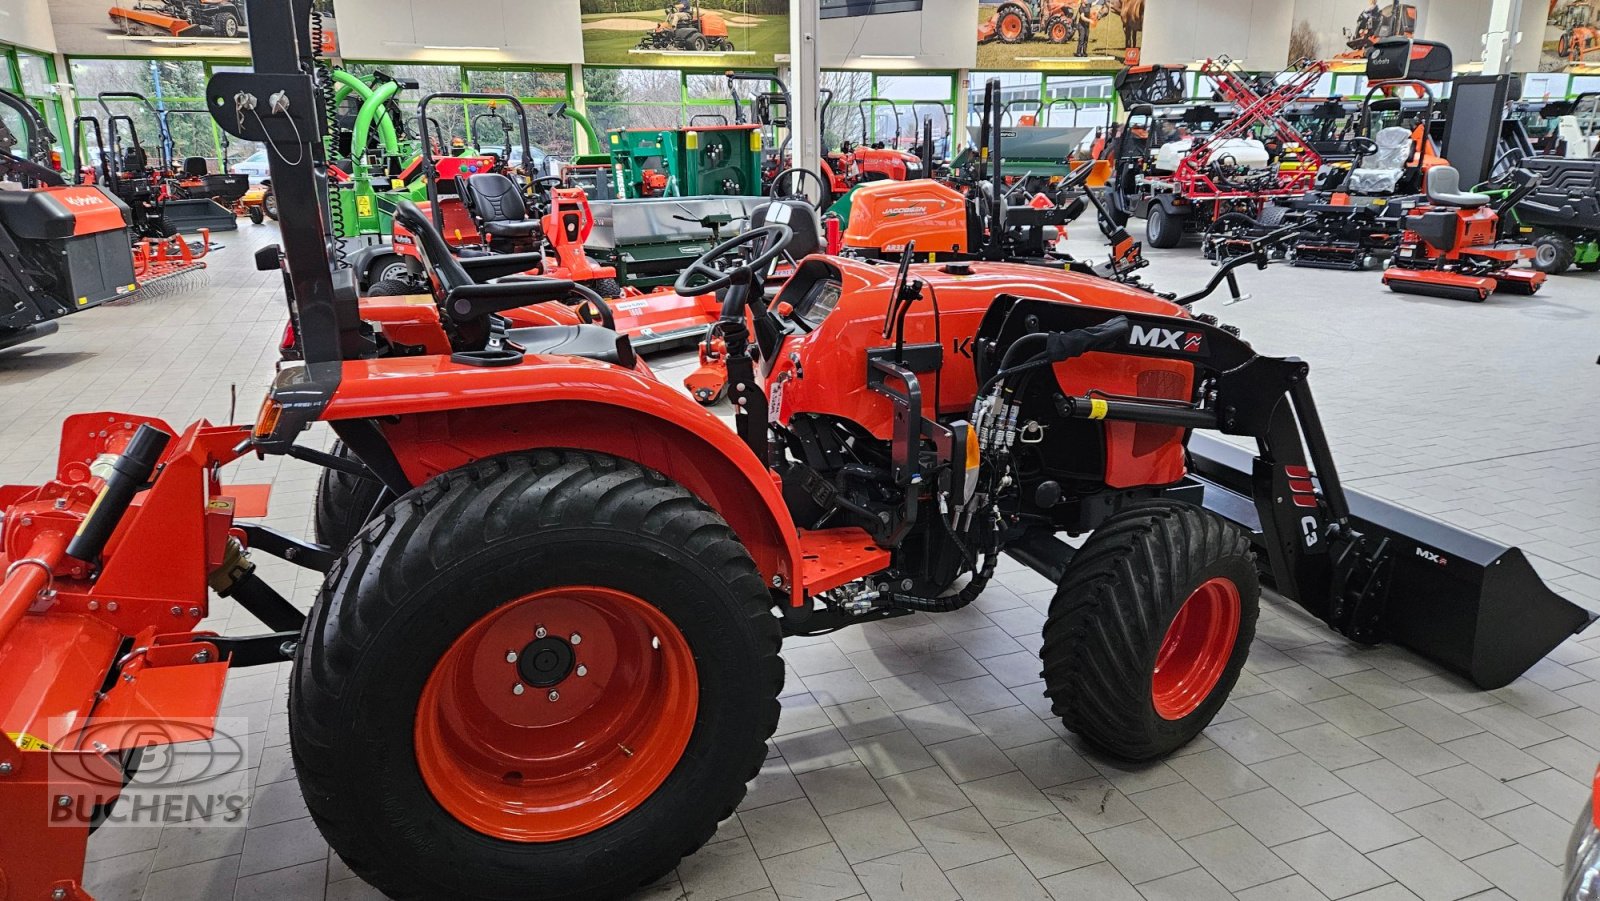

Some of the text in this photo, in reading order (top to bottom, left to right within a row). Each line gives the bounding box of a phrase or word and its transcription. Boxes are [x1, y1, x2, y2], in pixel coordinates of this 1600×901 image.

[881, 206, 927, 215] JACOBSEN
[1129, 325, 1185, 351] MX
[1301, 515, 1318, 547] C3
[1415, 547, 1440, 564] MX
